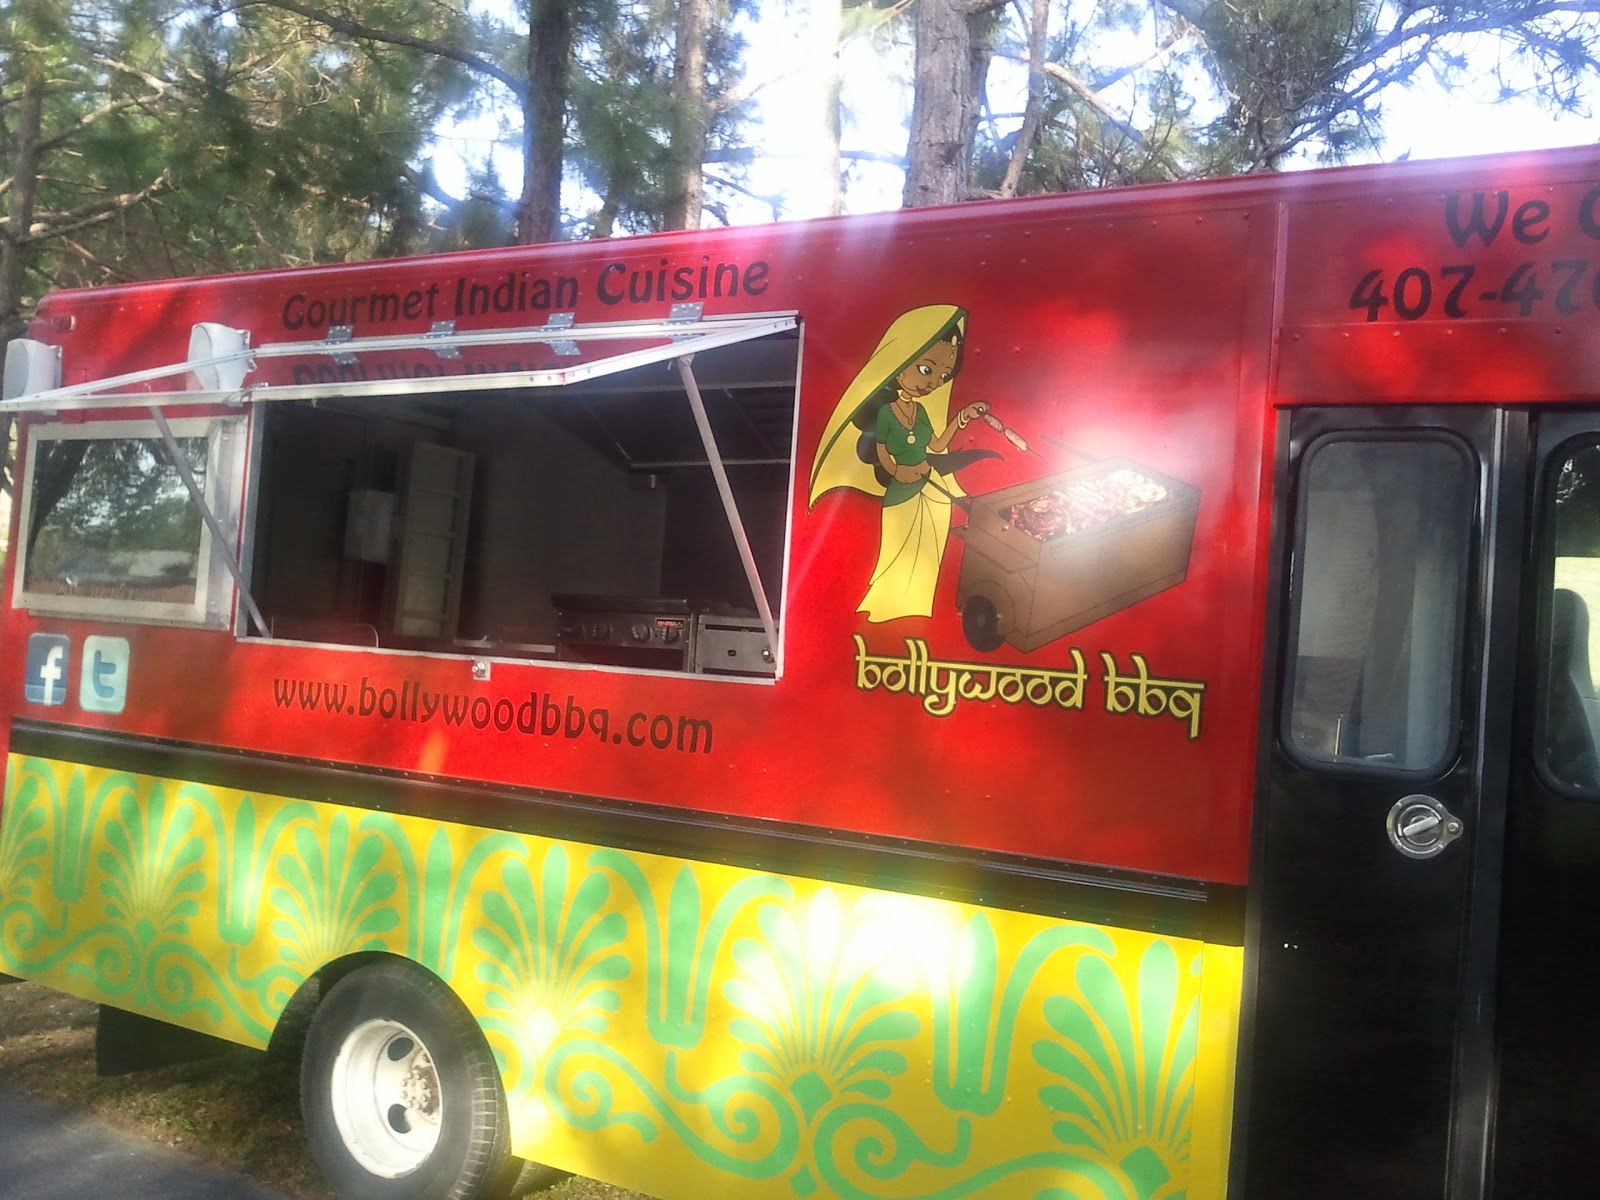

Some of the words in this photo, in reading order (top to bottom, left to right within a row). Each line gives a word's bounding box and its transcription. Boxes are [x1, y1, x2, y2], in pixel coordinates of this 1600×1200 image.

[1443, 191, 1550, 246] We
[282, 280, 440, 329] Gourmet
[454, 274, 579, 316] Indian
[599, 254, 770, 306] Cuisine
[1350, 260, 1600, 322] 407-47
[273, 677, 714, 754] www.bollywoodbbq.com
[854, 633, 1088, 717] bollywood
[1100, 648, 1206, 740] bbq
